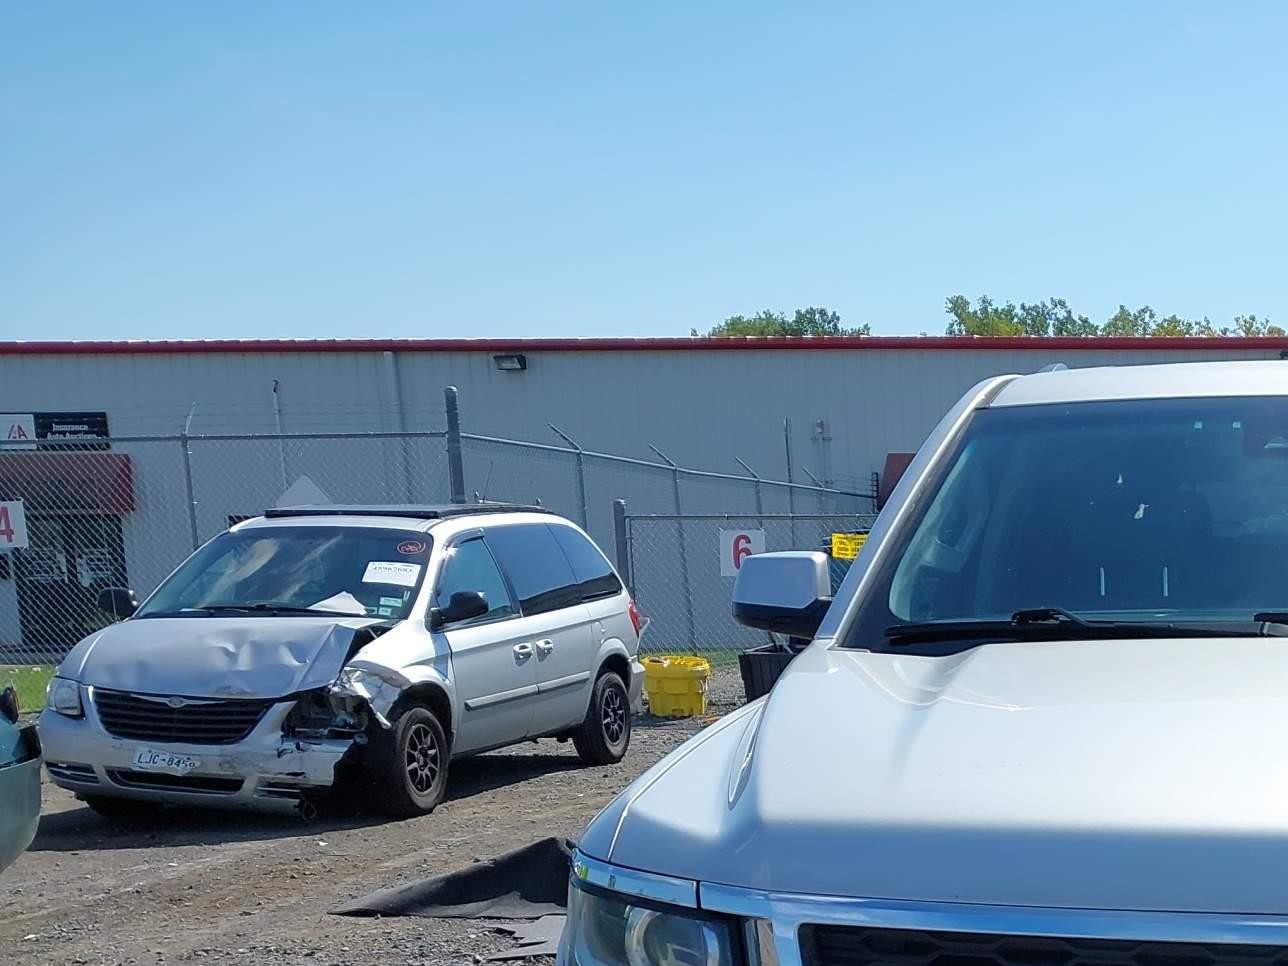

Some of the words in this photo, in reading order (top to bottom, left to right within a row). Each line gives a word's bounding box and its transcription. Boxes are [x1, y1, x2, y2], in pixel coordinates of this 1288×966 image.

[52, 423, 89, 431] Insurance
[0, 506, 15, 543] 4
[732, 534, 754, 570] 6
